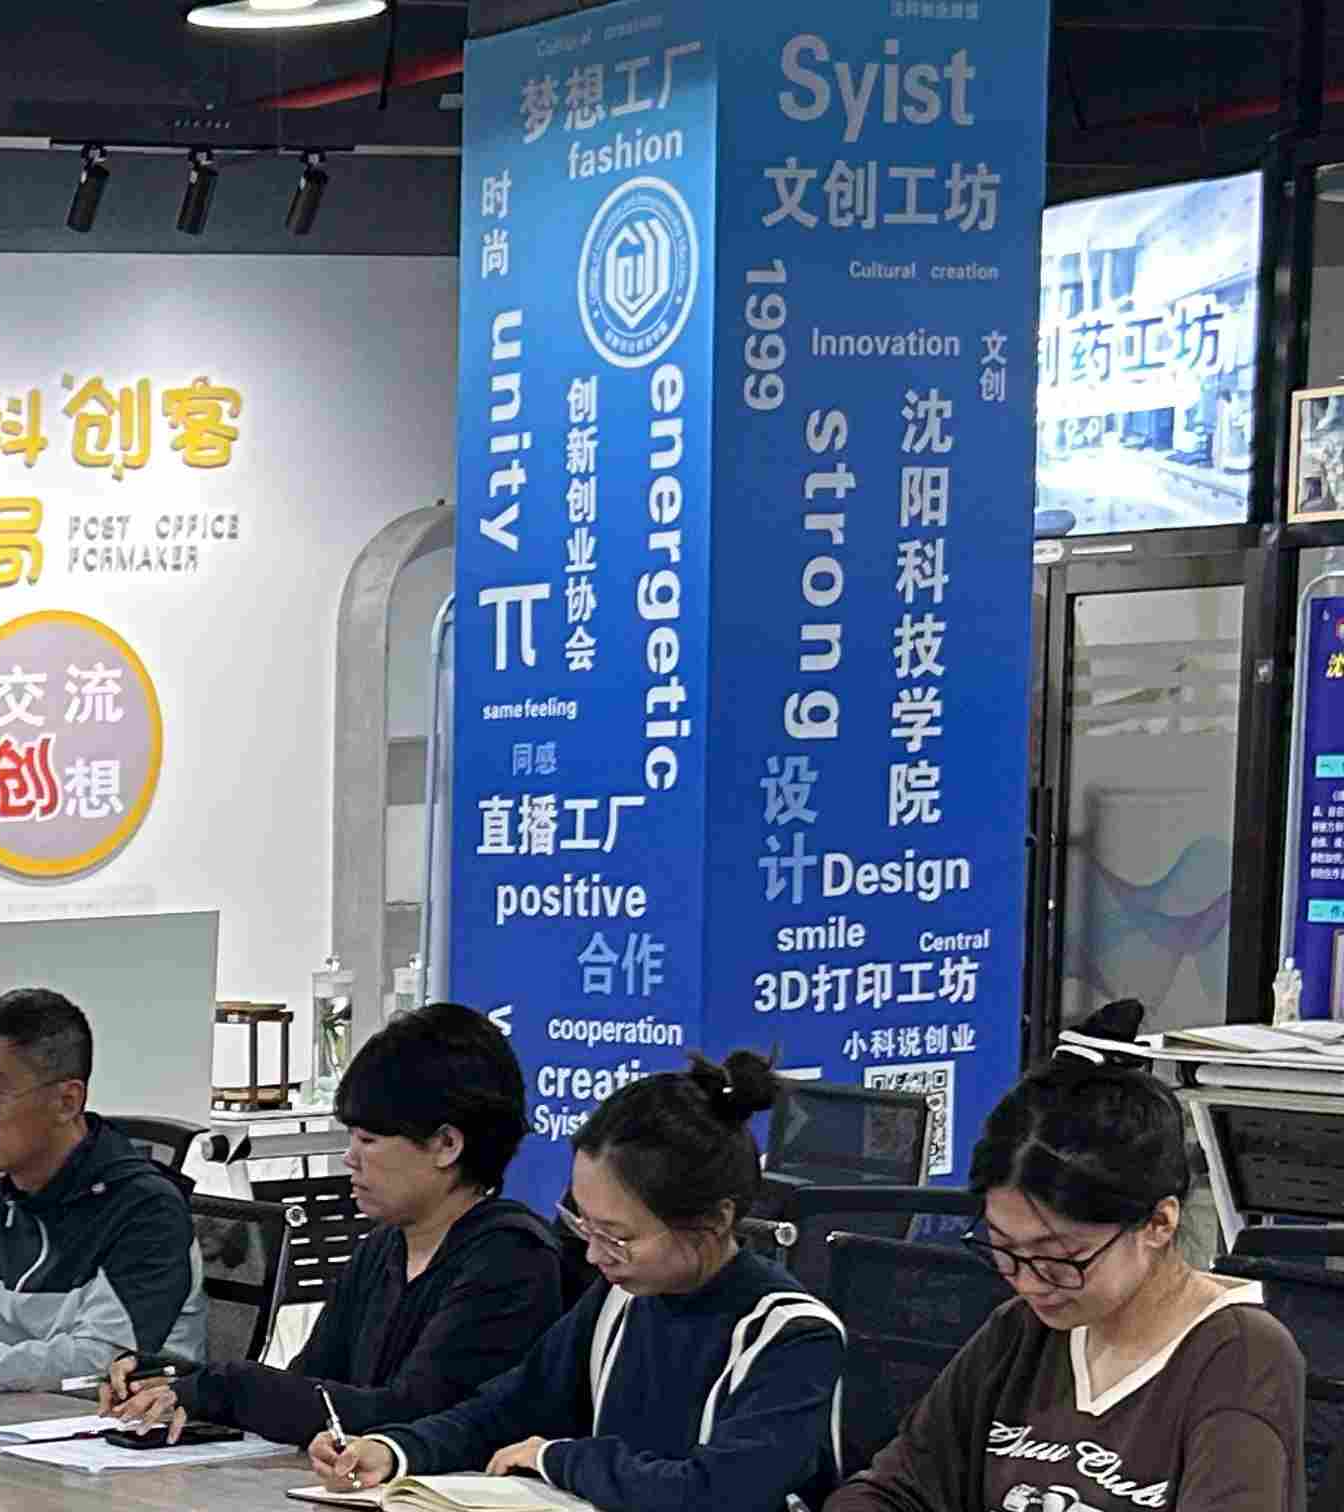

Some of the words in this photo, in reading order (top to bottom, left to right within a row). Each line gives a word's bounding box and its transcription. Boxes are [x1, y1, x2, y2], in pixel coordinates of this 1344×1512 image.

[521, 42, 701, 144] 梦想工厂
[779, 33, 976, 142] Syist
[567, 129, 683, 181] fashion
[480, 170, 511, 279] 时尚
[762, 158, 1002, 232] 文创工坊
[849, 260, 916, 280] Cultural
[930, 263, 1000, 281] creation
[743, 260, 787, 411] 1999
[811, 328, 960, 357] Innovation
[979, 330, 1008, 402] 文创
[480, 309, 532, 552] unity
[68, 514, 132, 541] POST
[155, 513, 242, 540] OFFICE
[564, 376, 599, 671] 创新创业协会
[637, 363, 691, 791] energetic
[784, 408, 856, 741] strong
[888, 388, 953, 827] 沈阳科技学院
[511, 743, 560, 777] 同感
[476, 795, 647, 857] 直播工厂
[756, 756, 820, 905] 设计
[496, 873, 648, 925] positive
[822, 850, 972, 902] Design
[576, 932, 666, 997] 合作
[776, 916, 867, 954] smile
[919, 928, 991, 954] Central
[754, 957, 981, 1015] 3D打印工坊
[548, 1015, 683, 1048] cooperation
[842, 1023, 978, 1061] 小科说创业
[537, 1059, 650, 1101] creati
